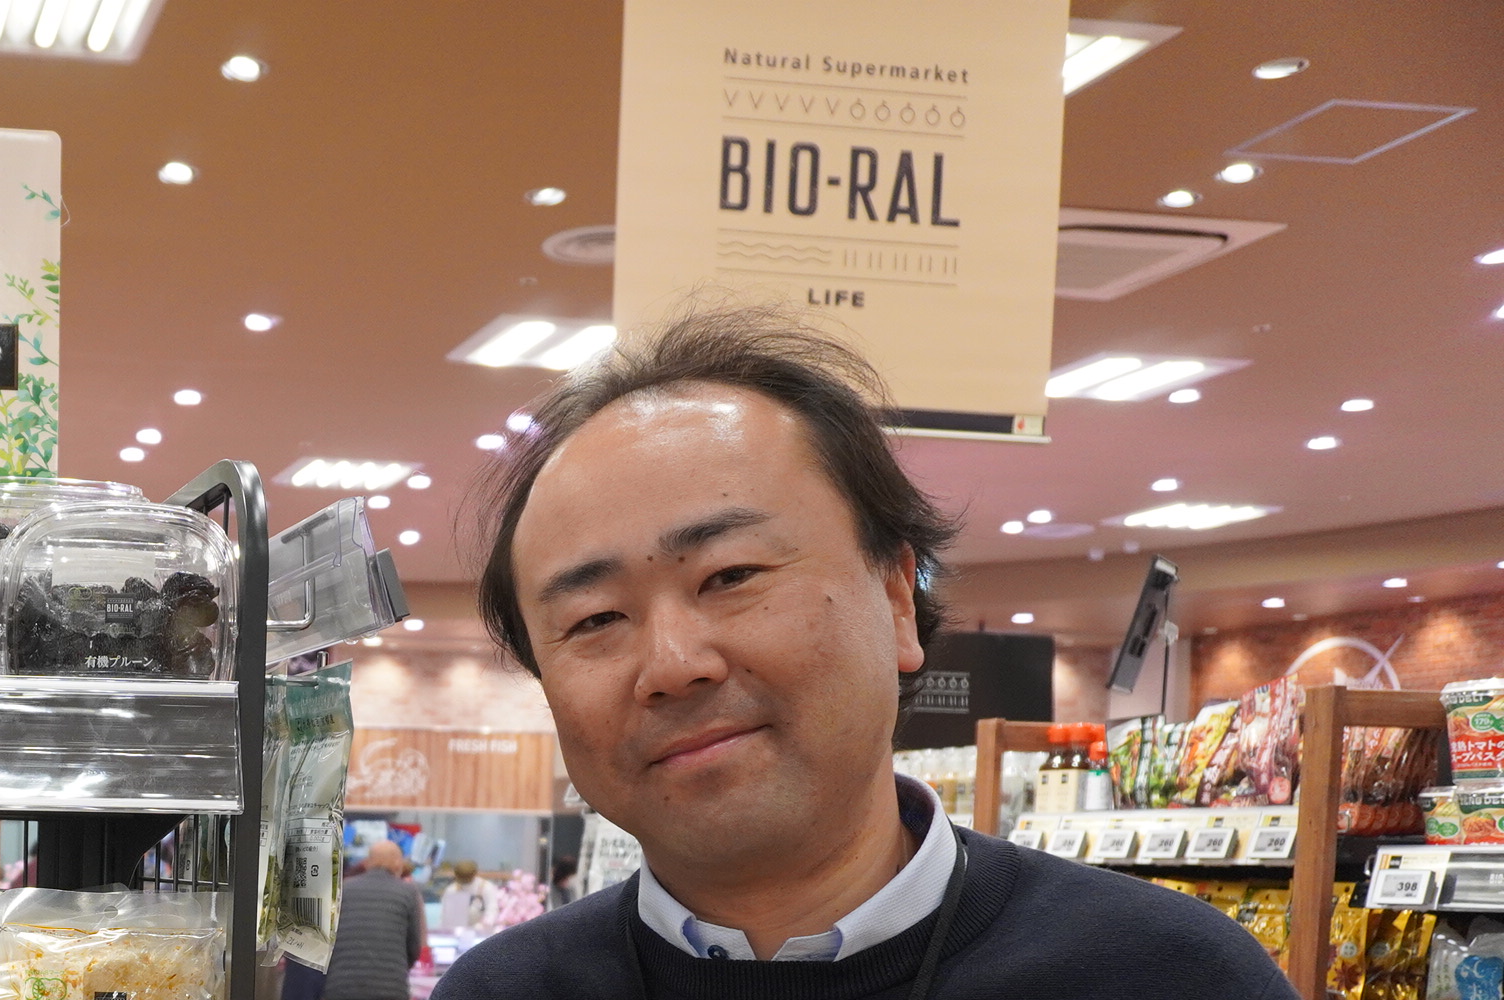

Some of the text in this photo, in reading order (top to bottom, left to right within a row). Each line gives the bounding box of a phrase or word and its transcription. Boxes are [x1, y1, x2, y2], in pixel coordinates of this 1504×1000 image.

[724, 47, 970, 84] Natural Supermarket
[718, 134, 961, 228] BIO-RAL
[807, 287, 866, 309] LIFE
[106, 602, 134, 614] BIO-RAL
[84, 655, 154, 669] 有機プルーン
[448, 739, 518, 755] FRESH FISH
[1206, 838, 1224, 847] 260
[1267, 837, 1286, 847] 260
[1396, 881, 1418, 893] 398
